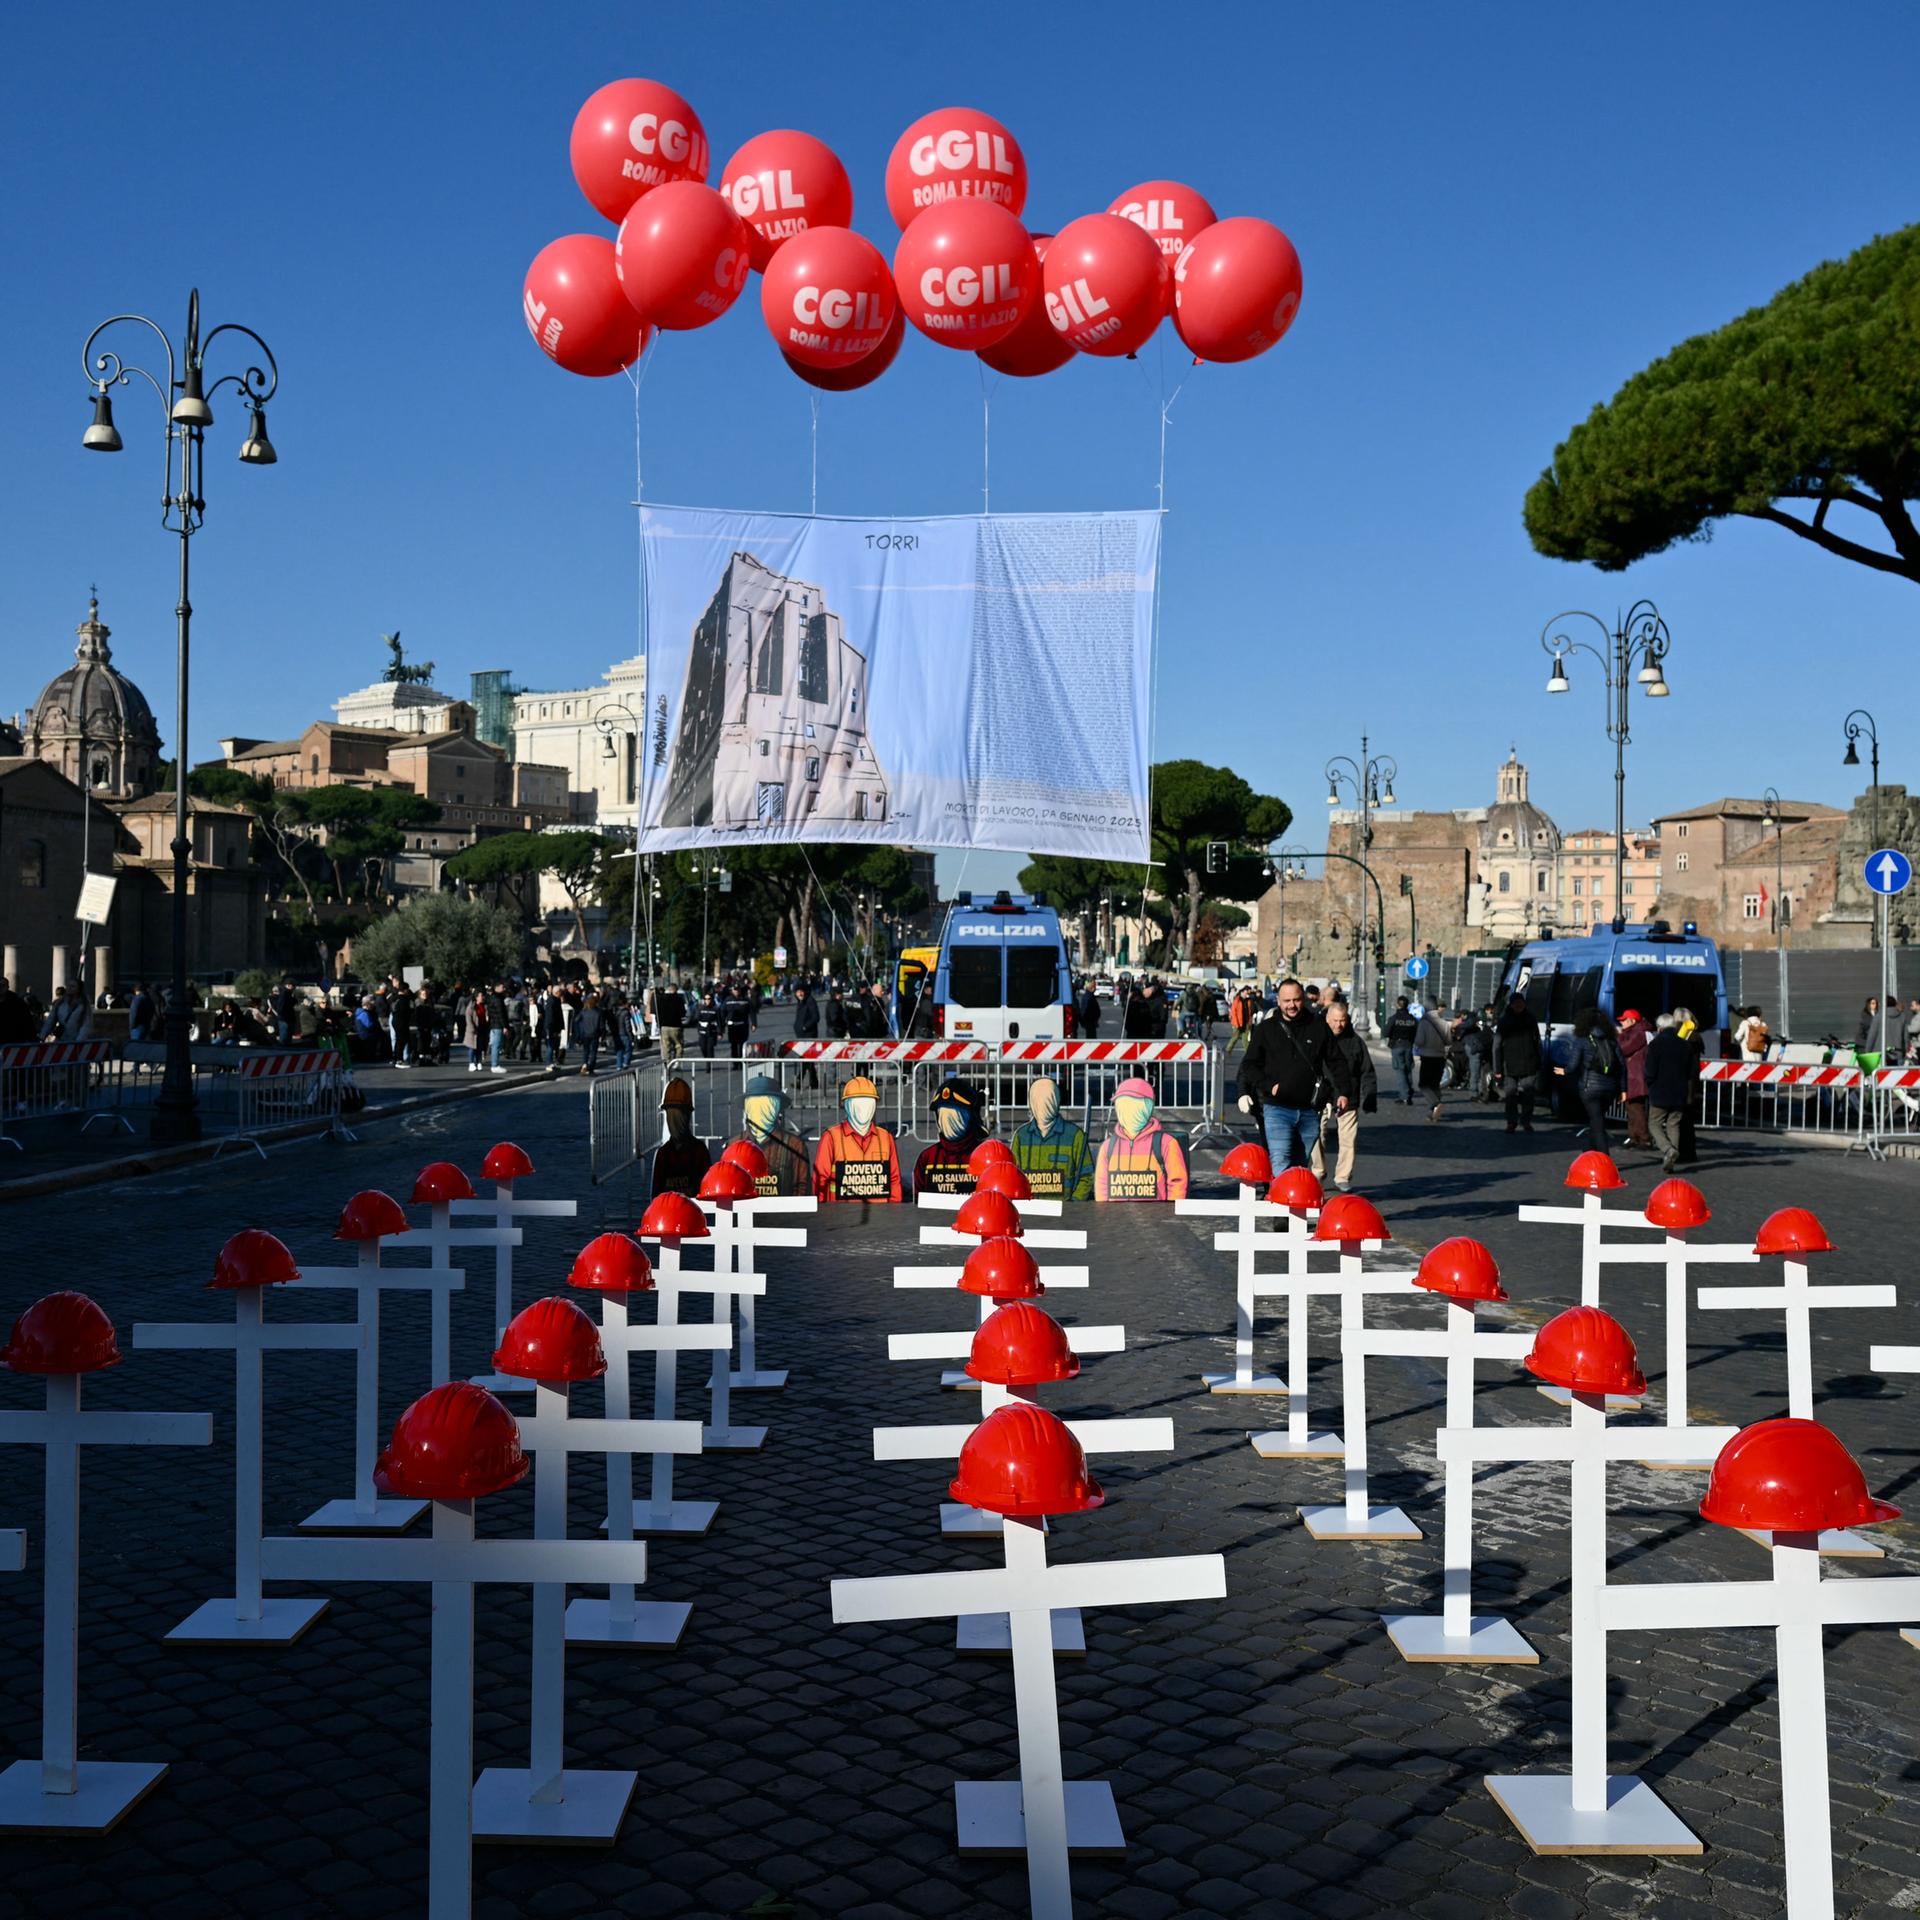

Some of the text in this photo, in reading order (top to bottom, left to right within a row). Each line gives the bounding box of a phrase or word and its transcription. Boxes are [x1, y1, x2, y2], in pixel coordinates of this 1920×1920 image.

[629, 113, 710, 178] CGIL
[909, 130, 1014, 176] CGIL
[912, 179, 1013, 207] ROMA E LAZIO
[1110, 200, 1184, 230] GIL
[766, 217, 808, 241] LAZIO
[1155, 237, 1184, 255] ZIO
[921, 263, 1020, 307] CGIL
[793, 286, 884, 330] CGIL
[1044, 278, 1111, 332] GIL
[924, 307, 1018, 331] ROMA E LAZIO
[789, 327, 830, 352] ROMA
[865, 534, 919, 551] TORRI
[944, 802, 976, 815] MORTI
[980, 805, 989, 815] DI
[993, 806, 1038, 819] LAVORO,
[1042, 809, 1056, 819] DA
[1059, 811, 1107, 826] GENNAIO
[1111, 816, 1142, 828] 2025
[959, 925, 1046, 937] POLIZIA
[1621, 954, 1706, 967] POLIZIA
[842, 1174, 888, 1185] ANDARE IN
[845, 1164, 883, 1175] DOVEVO
[932, 1173, 944, 1183] HO
[1052, 1173, 1061, 1183] DI
[1111, 1174, 1155, 1185] LAVORAVO
[937, 1183, 957, 1193] VITE,
[1111, 1185, 1156, 1197] DA 10 ORE
